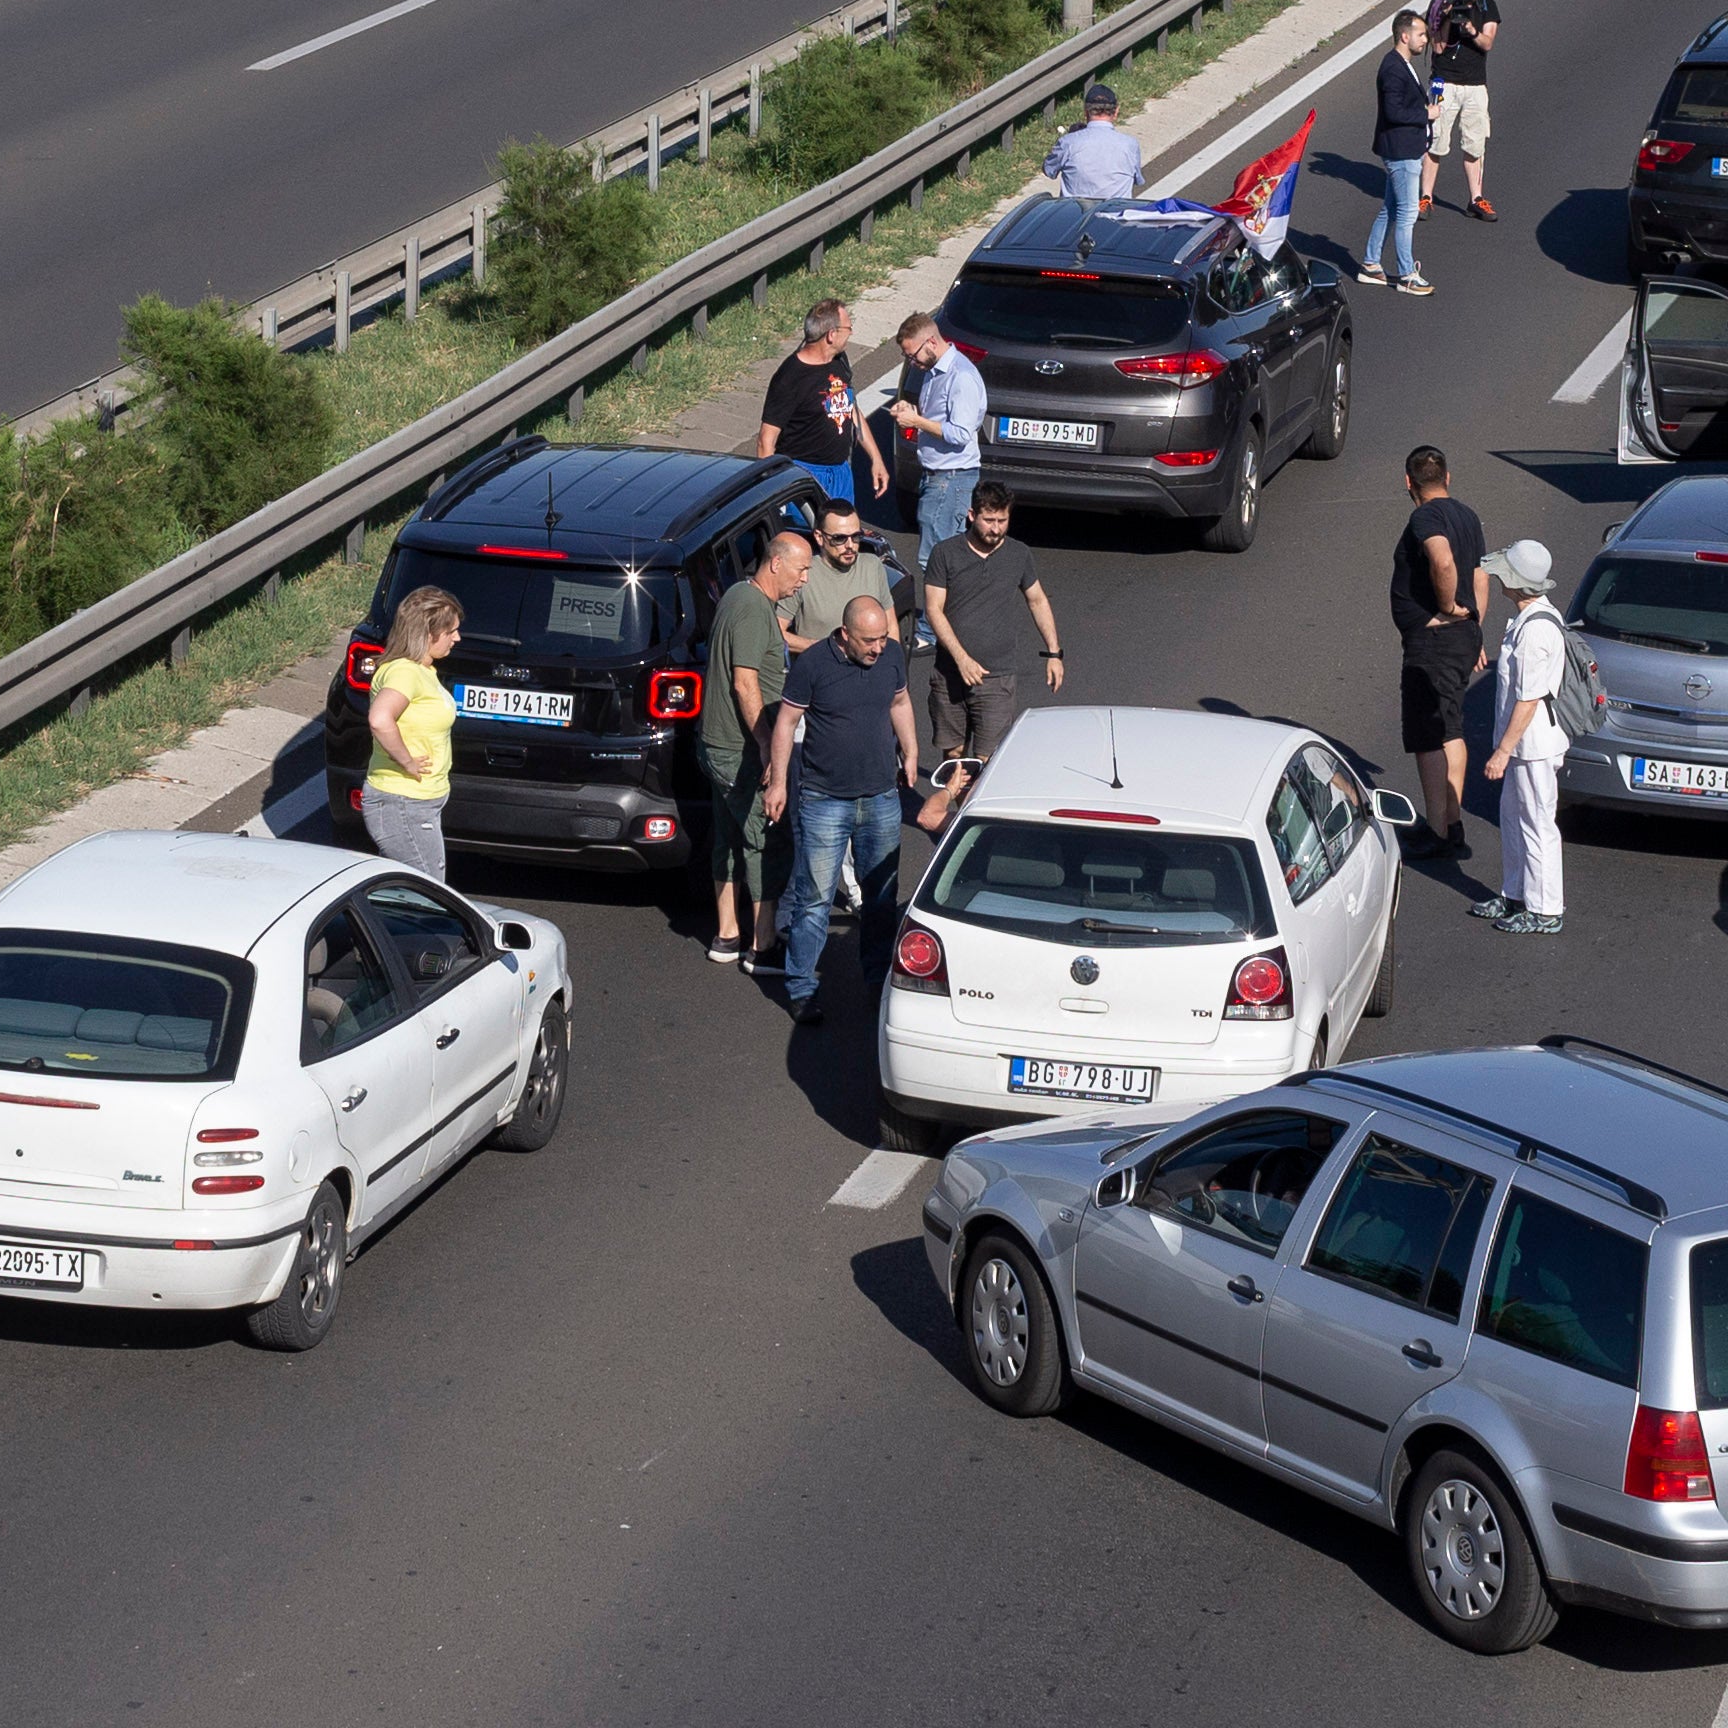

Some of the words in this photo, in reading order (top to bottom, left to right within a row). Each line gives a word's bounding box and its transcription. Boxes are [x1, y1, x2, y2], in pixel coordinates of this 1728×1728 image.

[1011, 421, 1030, 437] BG
[559, 597, 616, 617] PRESS
[466, 689, 487, 709] BG
[959, 988, 994, 1000] POLO
[1028, 1062, 1054, 1084] BG
